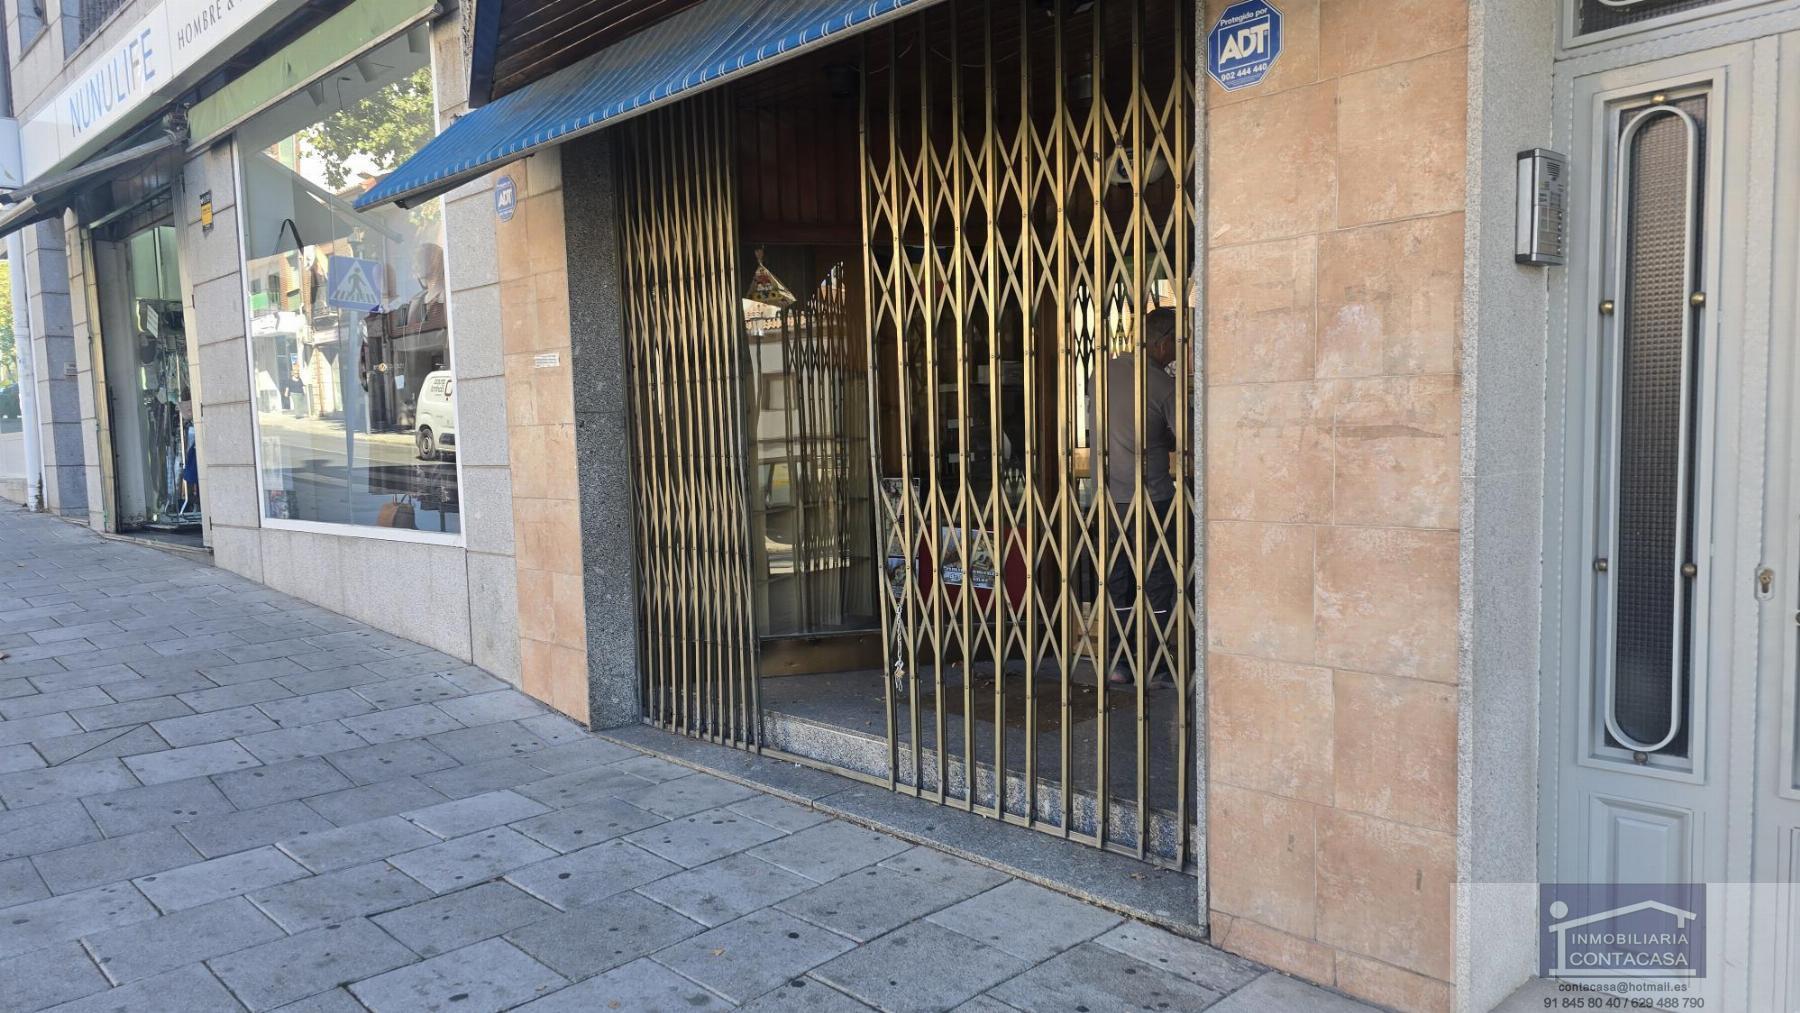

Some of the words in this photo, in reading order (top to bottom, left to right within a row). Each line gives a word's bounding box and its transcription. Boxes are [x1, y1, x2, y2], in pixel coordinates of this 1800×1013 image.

[177, 0, 223, 50] HOMBRE
[1220, 12, 1254, 26] Protegido
[1255, 8, 1268, 17] por
[1219, 23, 1270, 64] ADT
[69, 28, 156, 138] NUNULIFE
[1221, 71, 1236, 81] 902
[1237, 67, 1252, 77] 444
[1253, 62, 1268, 72] 440
